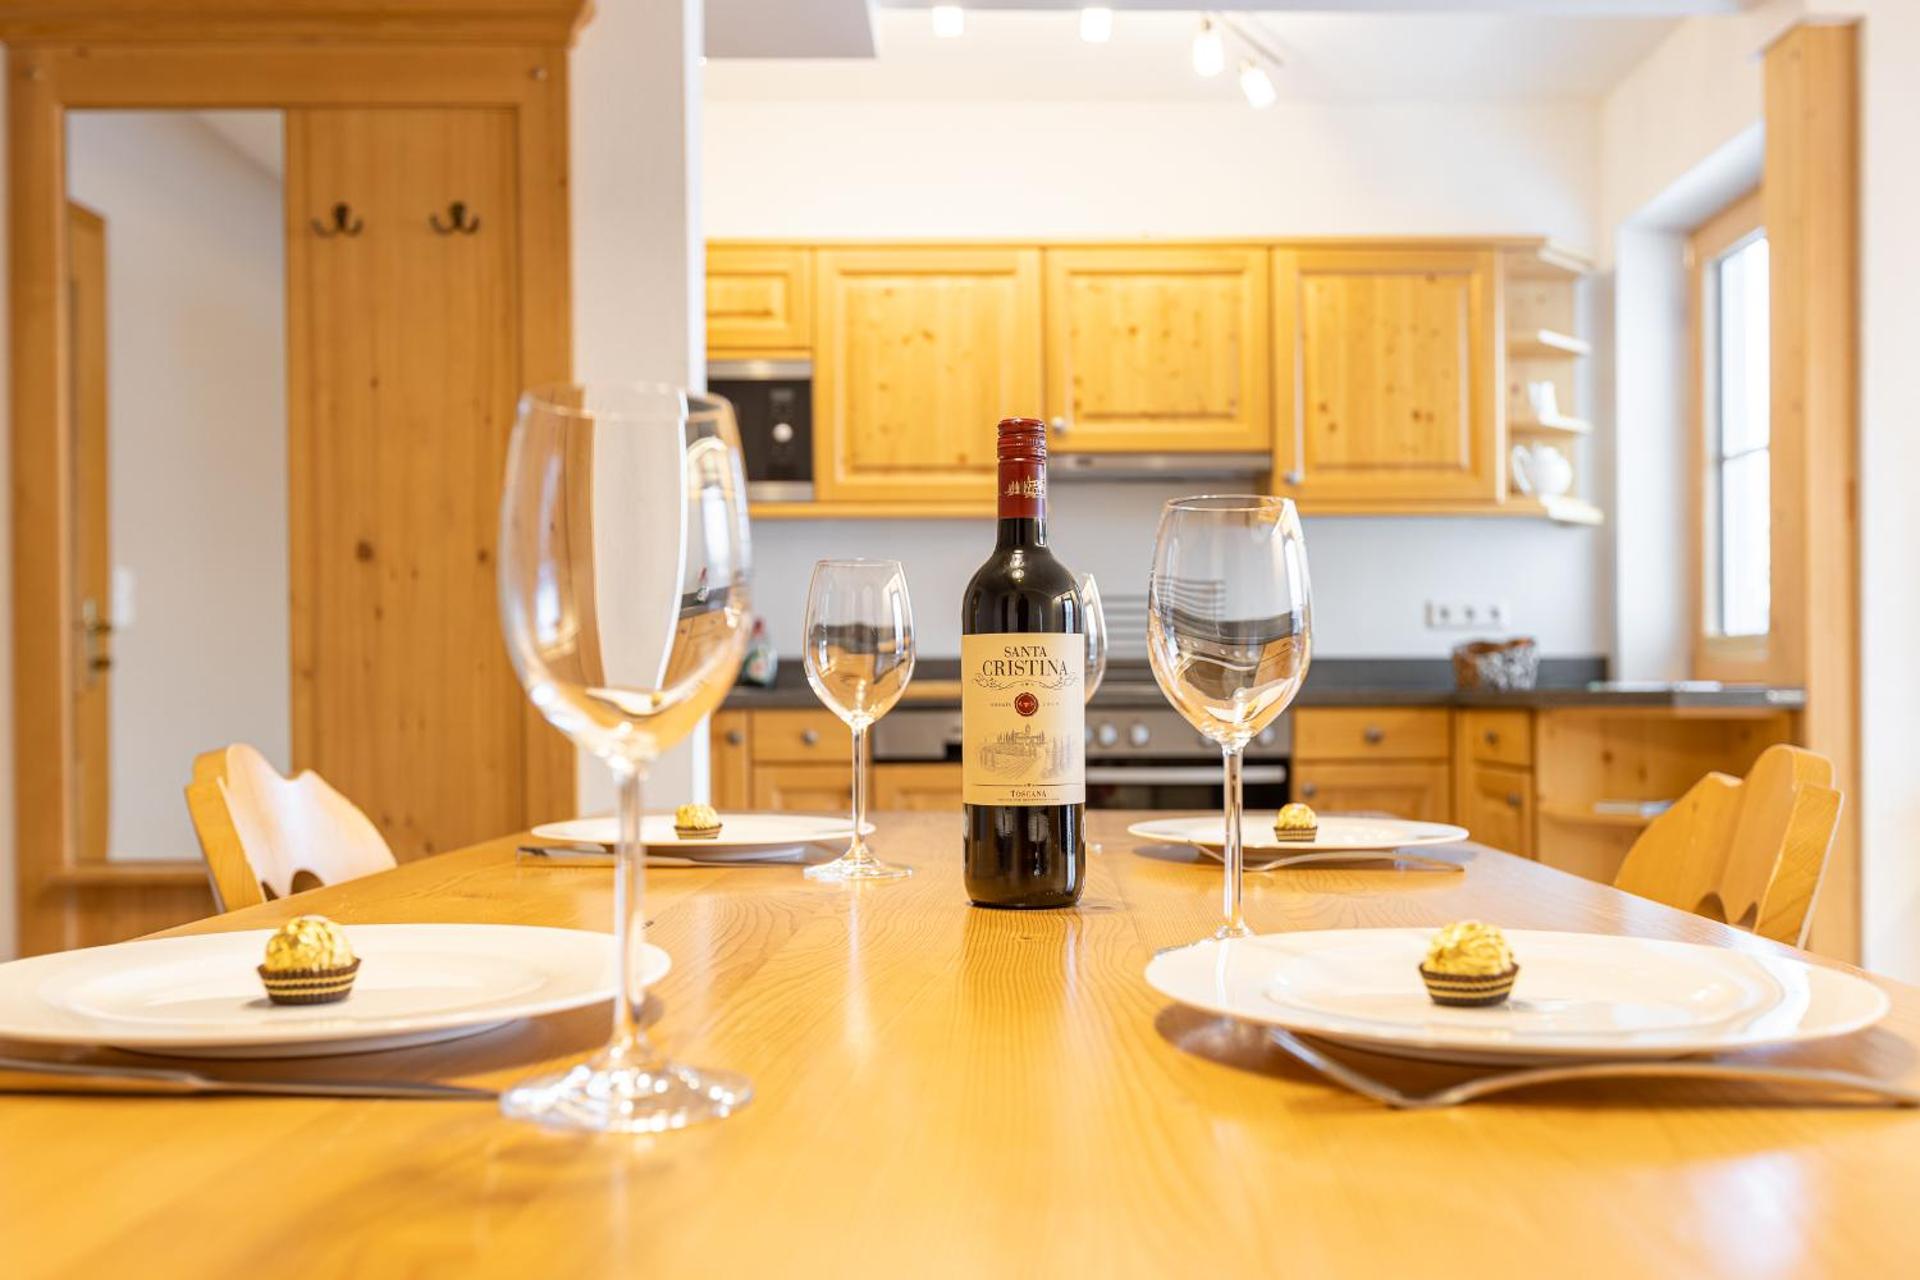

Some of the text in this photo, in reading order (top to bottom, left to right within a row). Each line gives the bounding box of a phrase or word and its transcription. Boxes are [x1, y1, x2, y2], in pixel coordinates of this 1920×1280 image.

[1004, 646, 1047, 658] SANTA
[982, 659, 1068, 676] CRISTINA
[1010, 790, 1047, 798] TOSCANA
